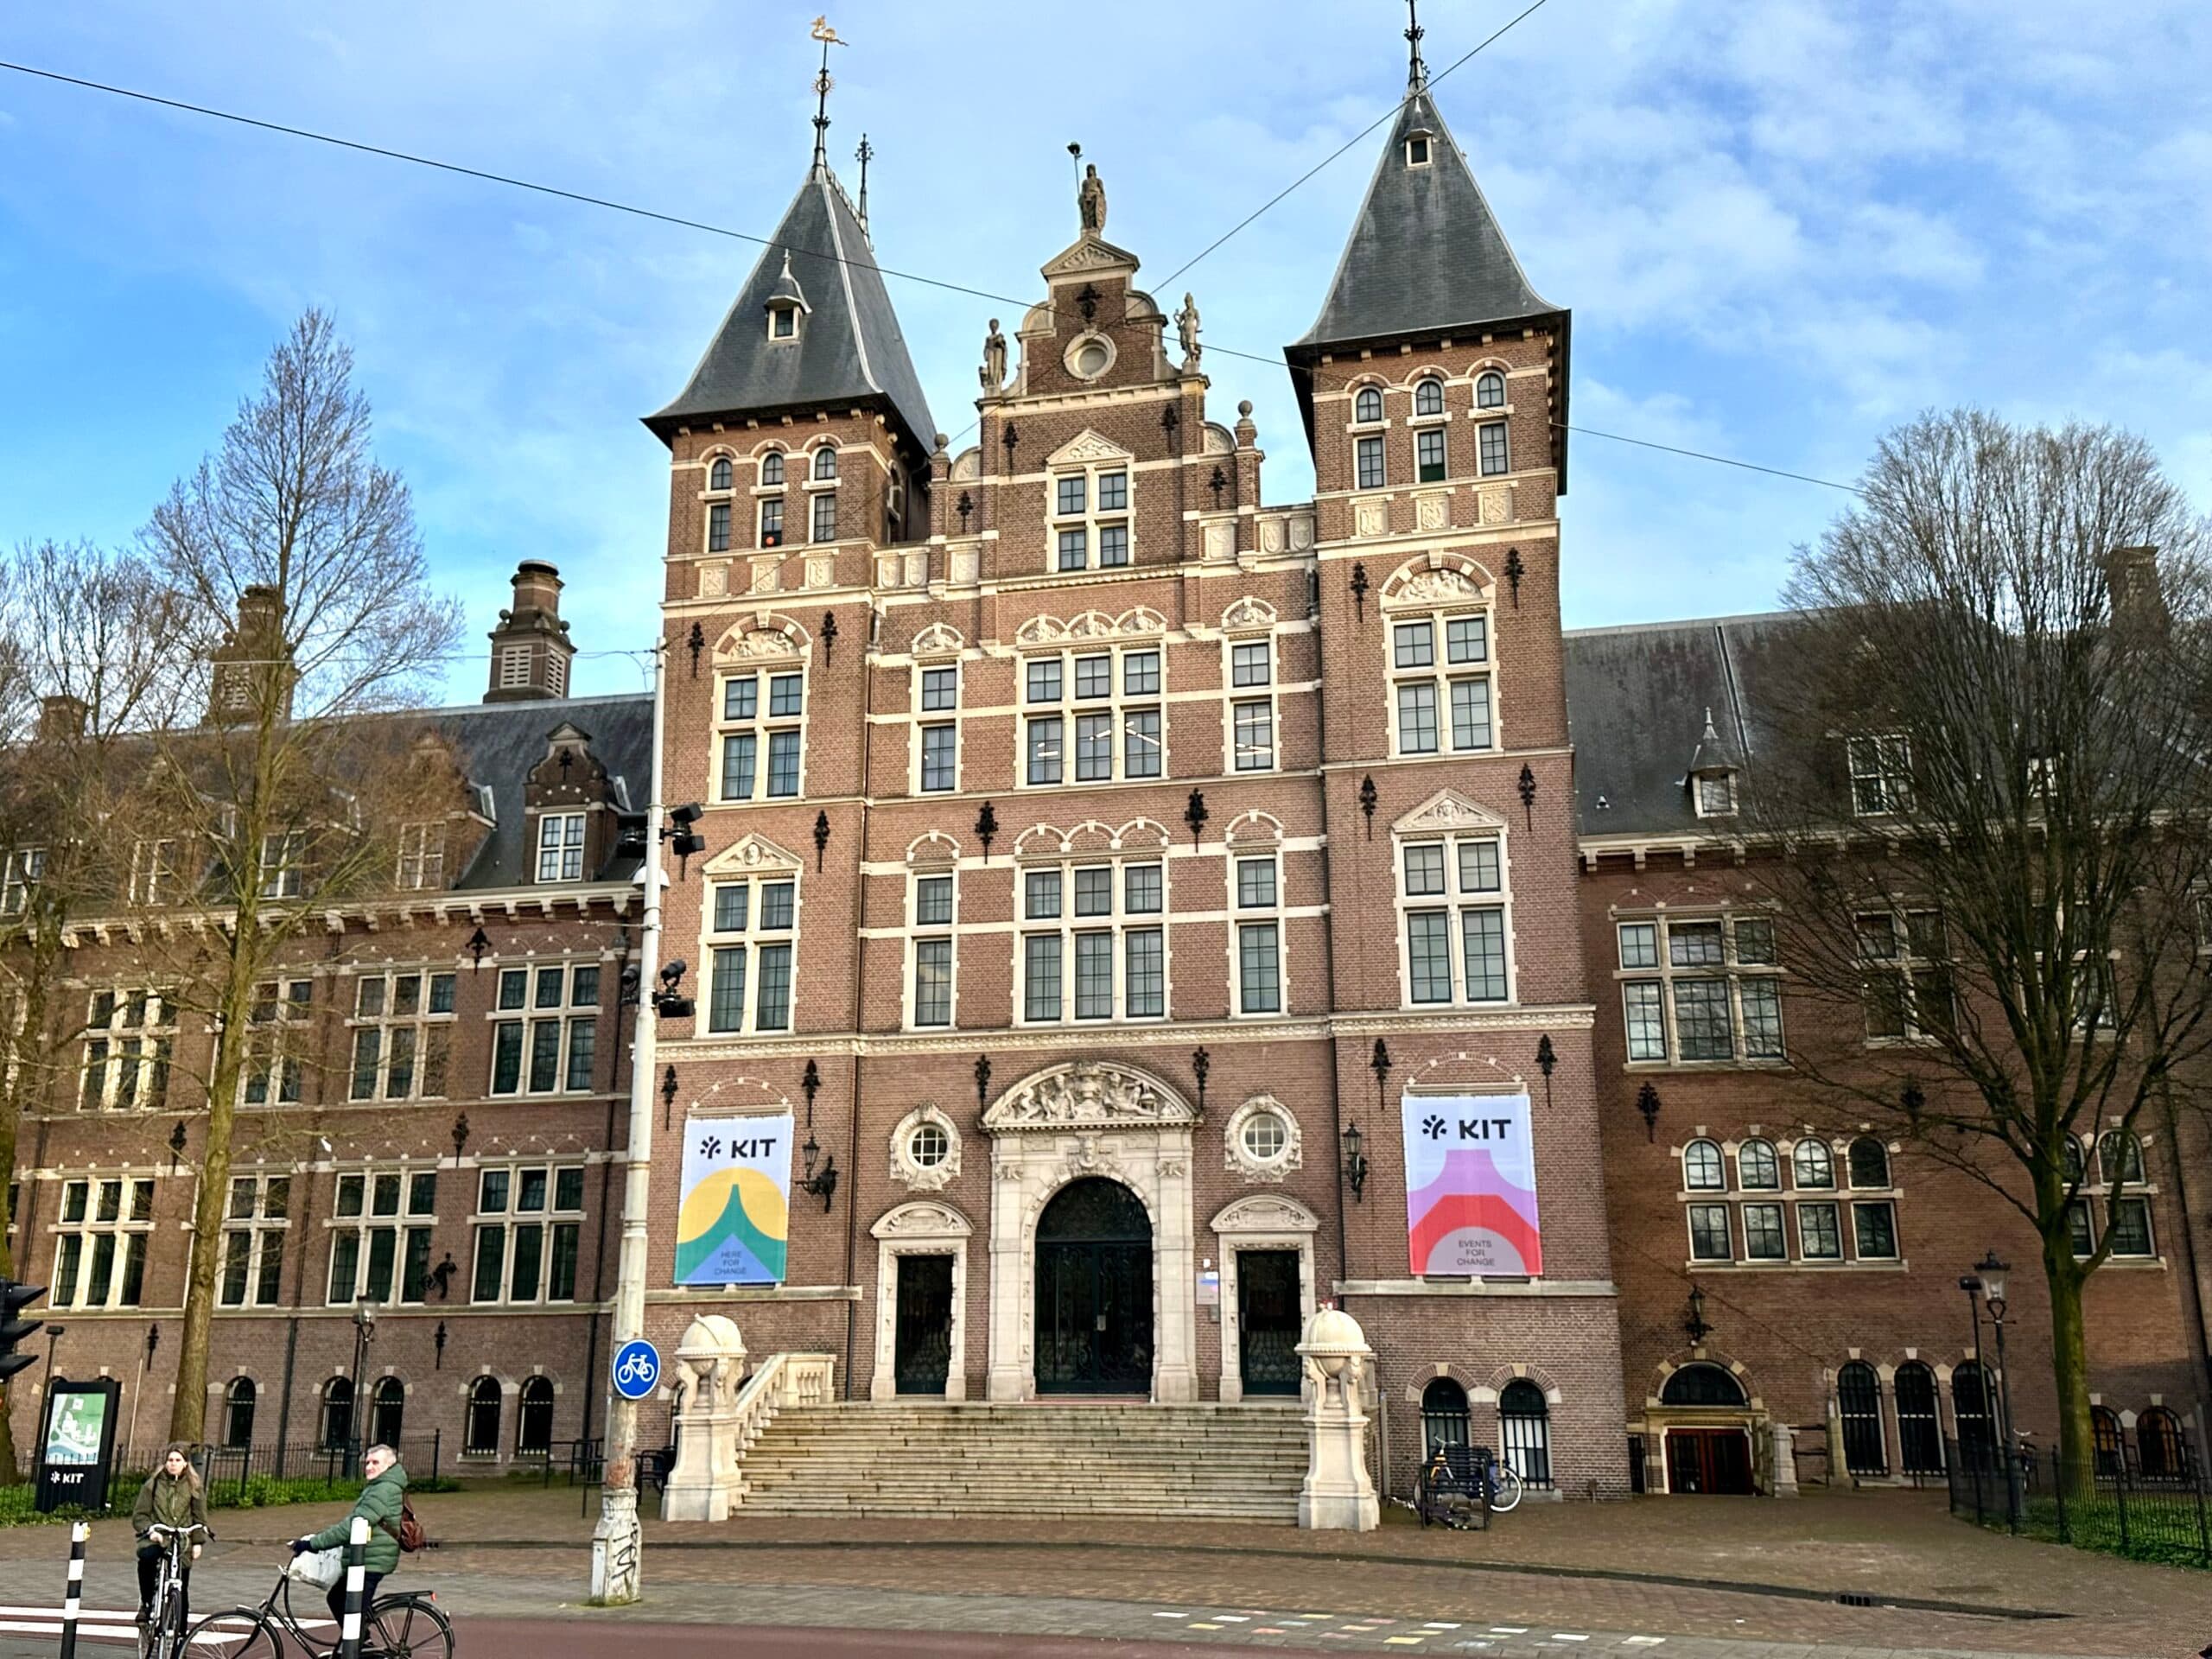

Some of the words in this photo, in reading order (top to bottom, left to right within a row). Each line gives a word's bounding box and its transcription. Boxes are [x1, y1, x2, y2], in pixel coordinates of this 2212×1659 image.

[1459, 1119, 1511, 1140] KIT
[731, 1138, 777, 1159] KIT
[1458, 1240, 1492, 1249] EVENTS
[721, 1250, 742, 1259] HERE
[1456, 1257, 1496, 1267] CHANGE
[714, 1267, 747, 1275] CHANGE
[62, 1472, 84, 1484] KIT
